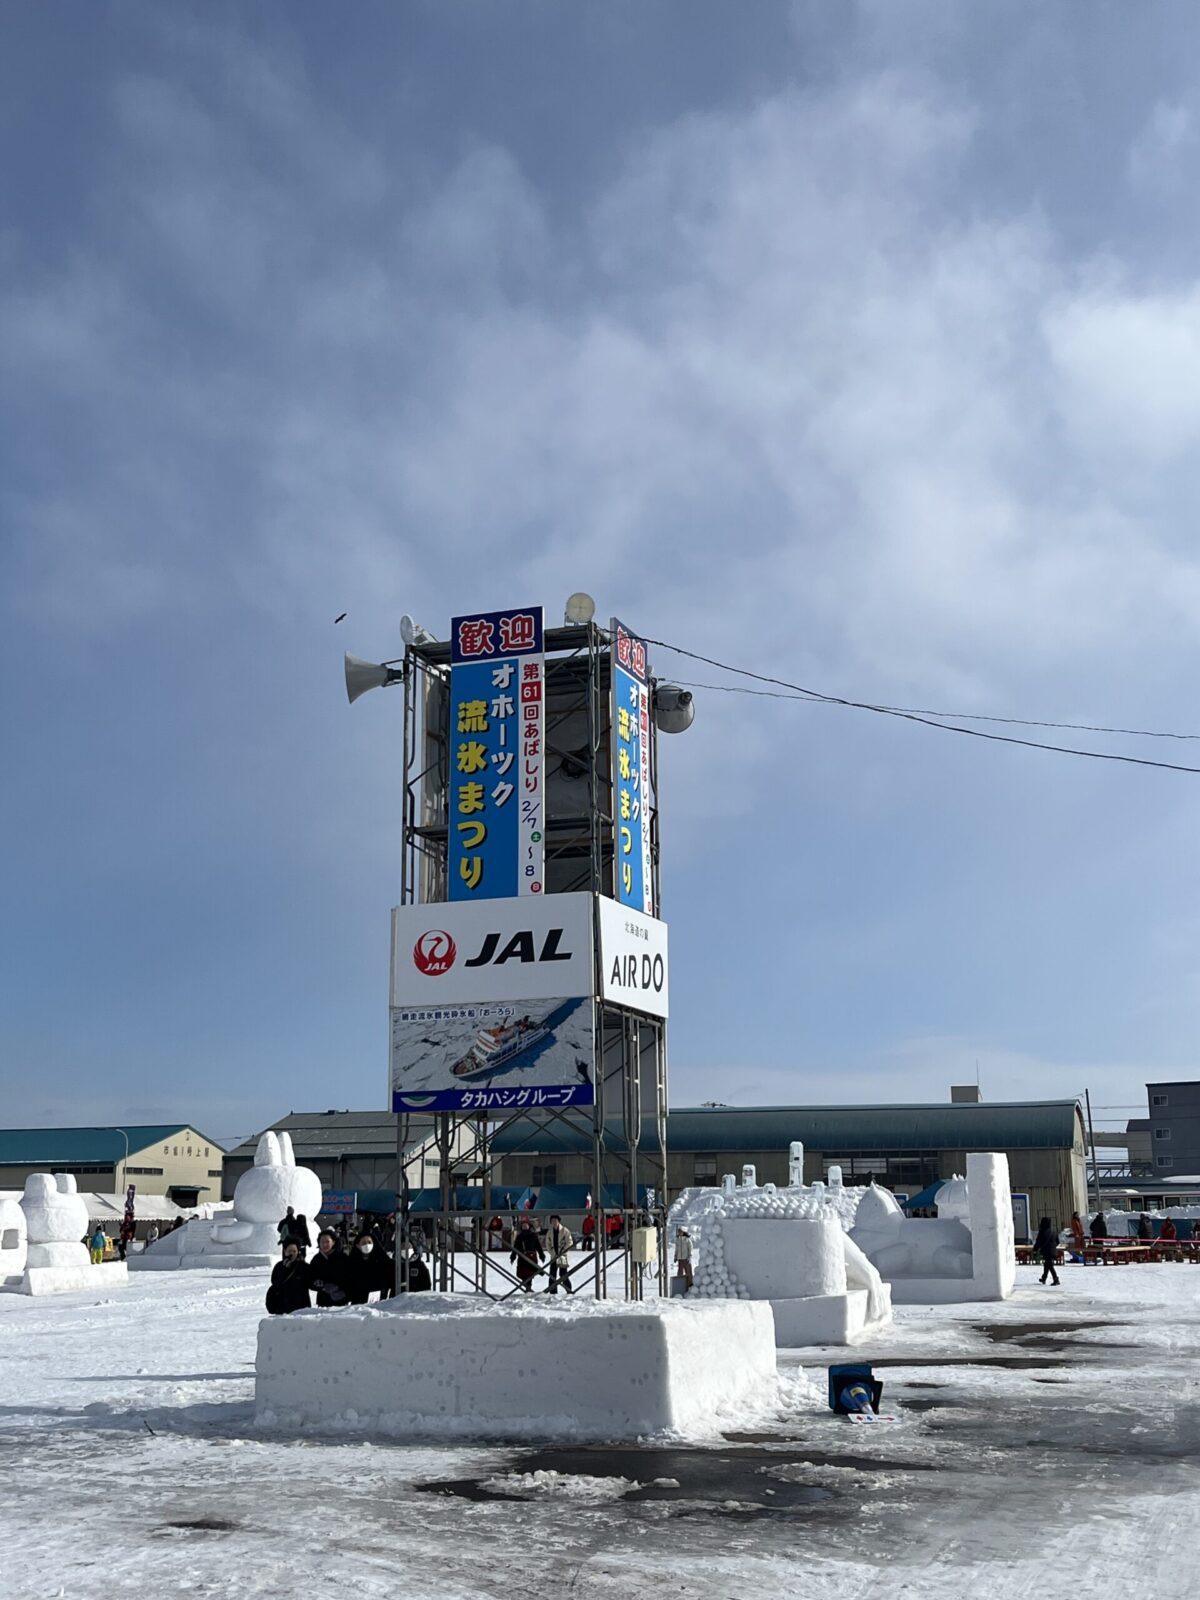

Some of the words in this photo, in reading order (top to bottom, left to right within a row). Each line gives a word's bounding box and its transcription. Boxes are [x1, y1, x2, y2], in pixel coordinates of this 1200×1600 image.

[459, 614, 536, 656] 歓迎
[616, 625, 646, 680] 歓迎
[491, 664, 515, 807] オホーツク
[629, 683, 639, 822] オホーツク
[456, 699, 488, 889] 流氷まつり
[618, 705, 632, 896] 流氷まつり
[424, 962, 448, 972] JAL
[464, 929, 573, 967] JAL
[610, 955, 637, 988] AIR
[642, 953, 664, 993] DO
[460, 1086, 576, 1108] タカハシグループ
